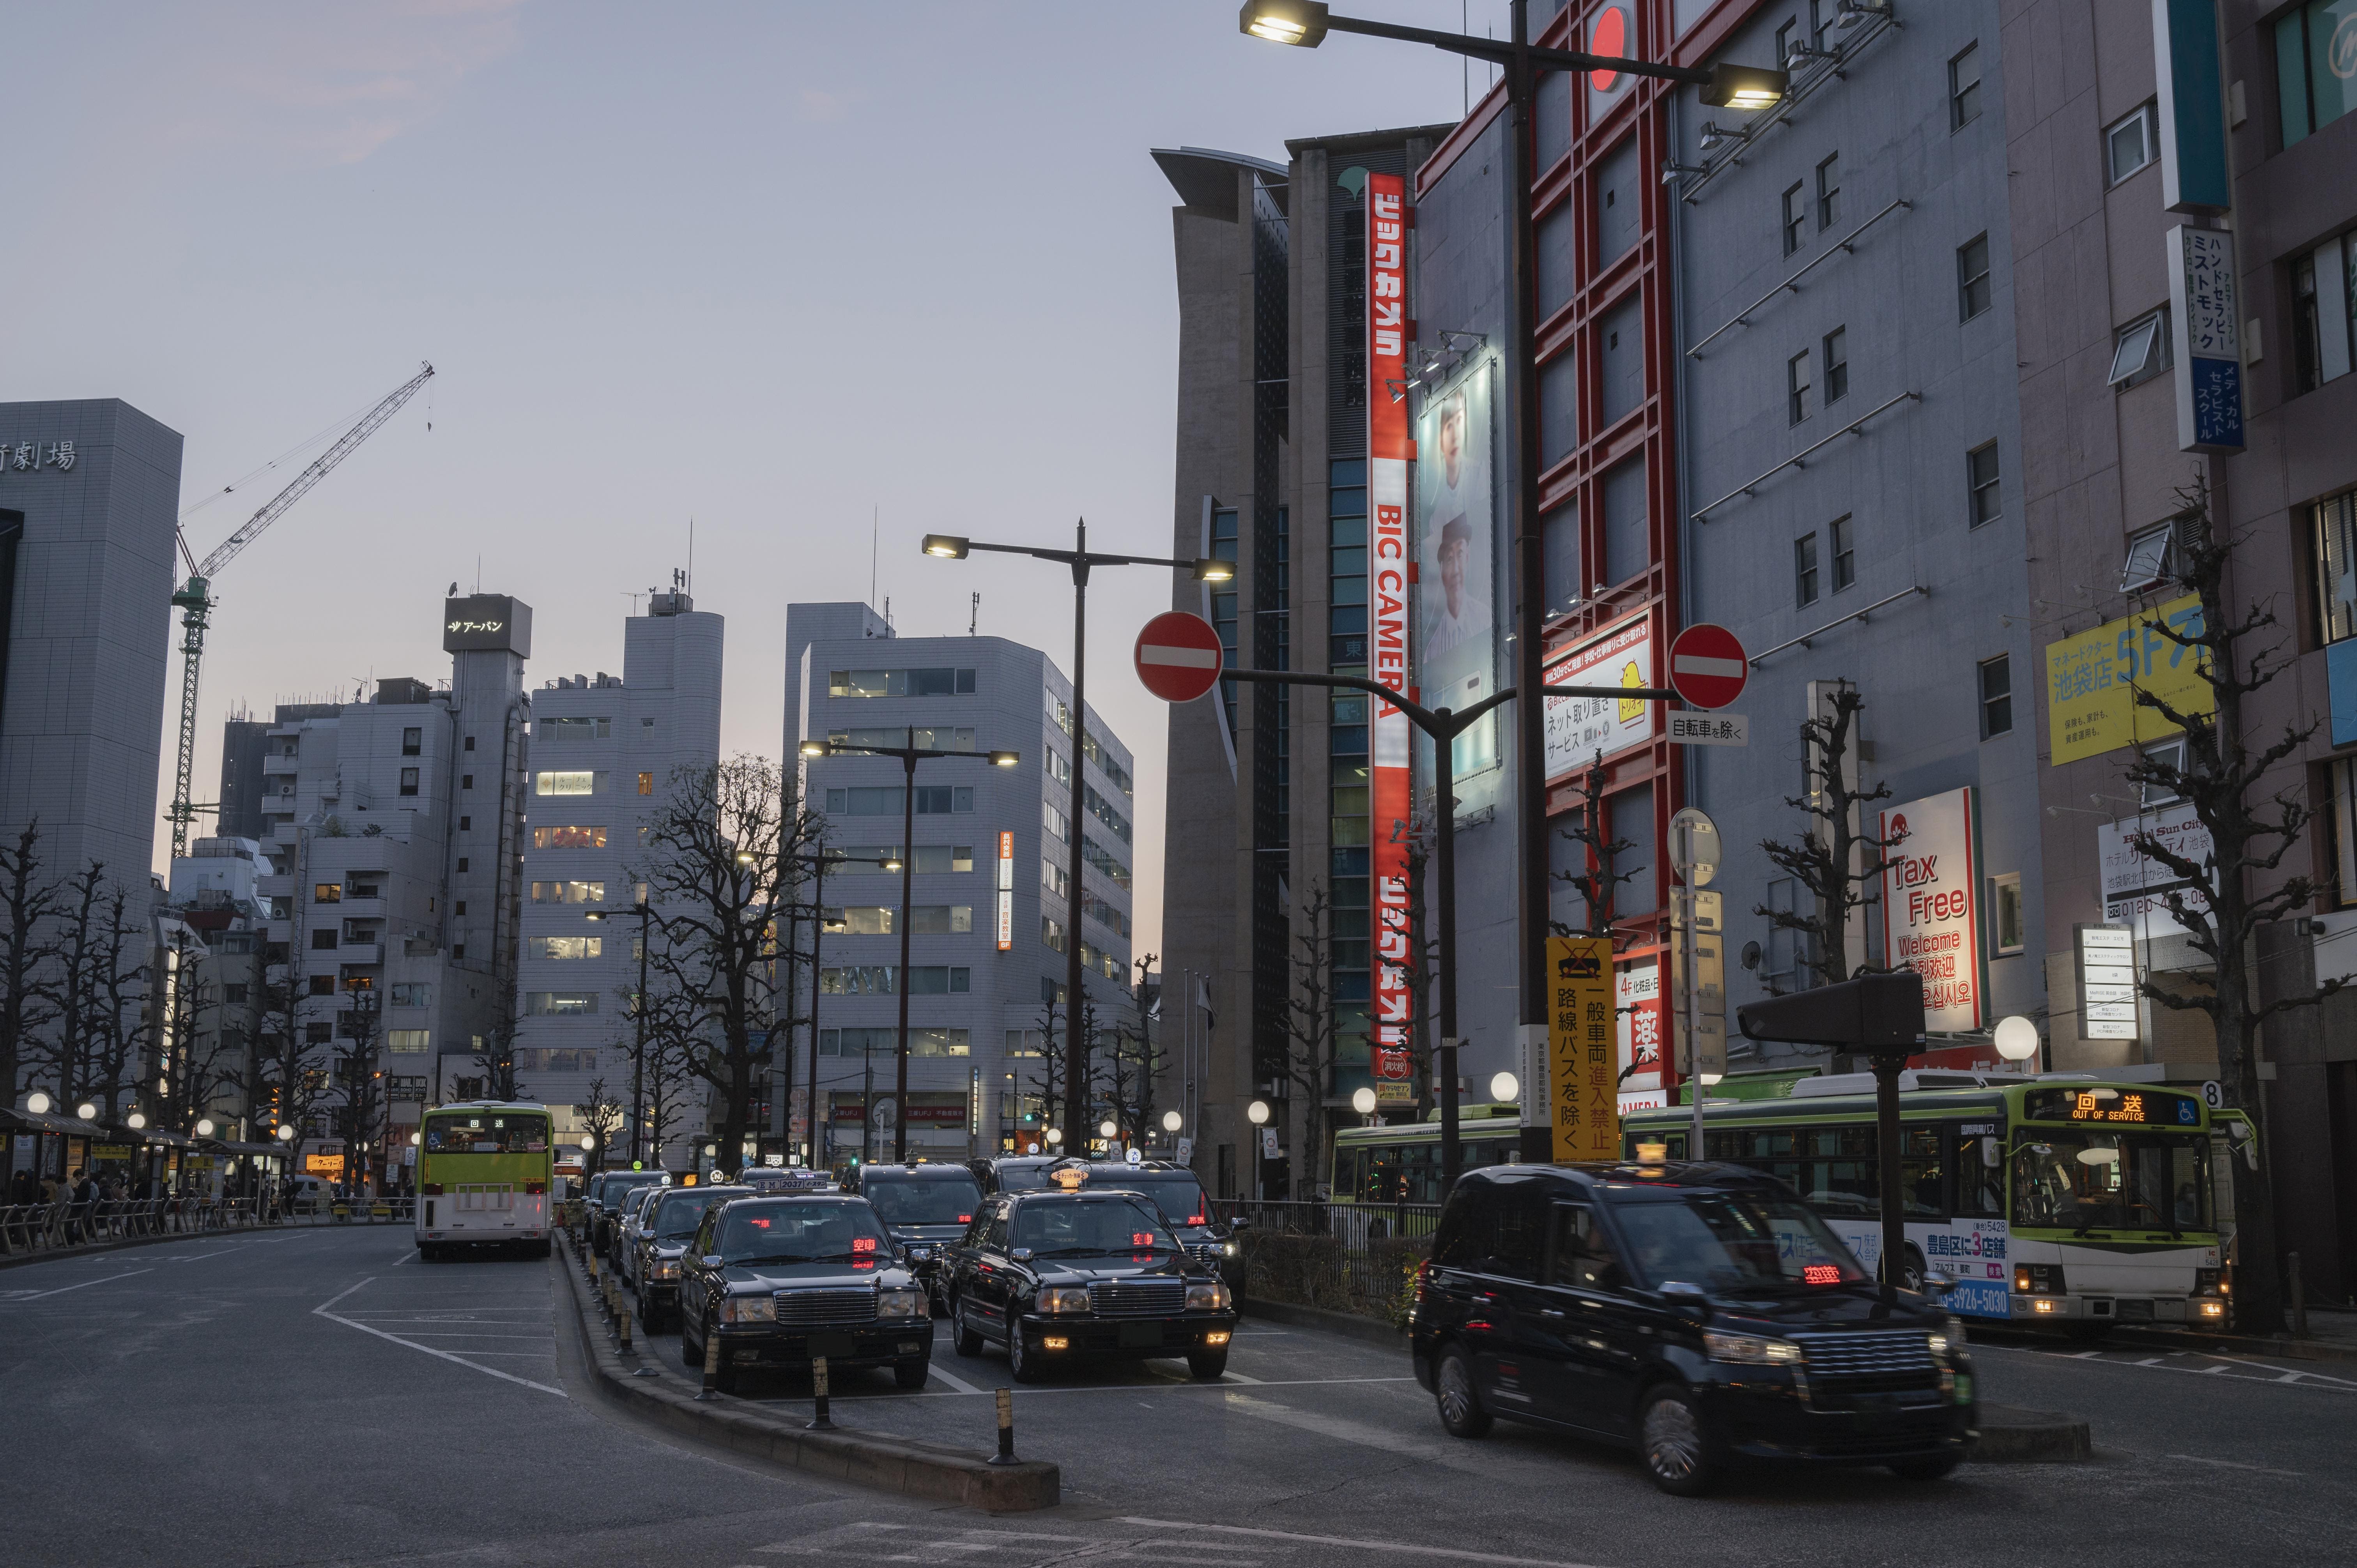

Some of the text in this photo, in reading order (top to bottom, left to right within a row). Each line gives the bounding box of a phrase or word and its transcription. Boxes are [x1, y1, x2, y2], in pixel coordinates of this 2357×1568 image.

[1375, 193, 1400, 355] ビックカメラ
[2195, 235, 2214, 350] ミストモック
[2210, 238, 2225, 351] ハンドセラピー
[2210, 371, 2224, 436] セラピスト
[2224, 366, 2238, 430] メディカル
[2198, 388, 2212, 440] スクール
[1378, 504, 1402, 560] BIC
[464, 621, 502, 633] アーバン
[2053, 640, 2112, 668] マネードクター
[2117, 626, 2164, 682] 5F
[2054, 657, 2113, 704] 池袋店
[1674, 718, 1741, 739] 自転車を除く
[2065, 711, 2108, 730] 保険も、家計も、
[1548, 732, 1579, 759] サービス
[2065, 727, 2100, 744] 資産運用も。
[2156, 825, 2180, 837] Sun
[2182, 819, 2205, 831] City
[1890, 854, 1938, 890] Tax
[1908, 889, 1966, 927] Free
[2122, 898, 2152, 916] 0120
[1898, 930, 1961, 959] Welcome
[1621, 980, 1632, 996] 4F
[1635, 1010, 1659, 1062] 薬
[1385, 1061, 1404, 1072] 消火栓
[1537, 1043, 1546, 1116] 東京都豊島都税事務所
[1557, 988, 1580, 1150] 路線バスを除く
[1585, 988, 1610, 1150] 一般車両進入禁止
[416, 1078, 426, 1087] BOX
[1379, 1084, 1386, 1092] 質
[2206, 1083, 2218, 1106] 8
[2073, 1110, 2145, 1121] OUT OF SERVICE
[2078, 1094, 2142, 1113] 回送
[471, 1119, 503, 1128] 回送
[1132, 1151, 1138, 1162] 大和
[853, 1239, 875, 1251] 空車
[1133, 1233, 1153, 1245] 空車
[1927, 1232, 2006, 1259] 豊島区に3店舗
[1935, 1262, 2001, 1276] アルプス 要町 検索
